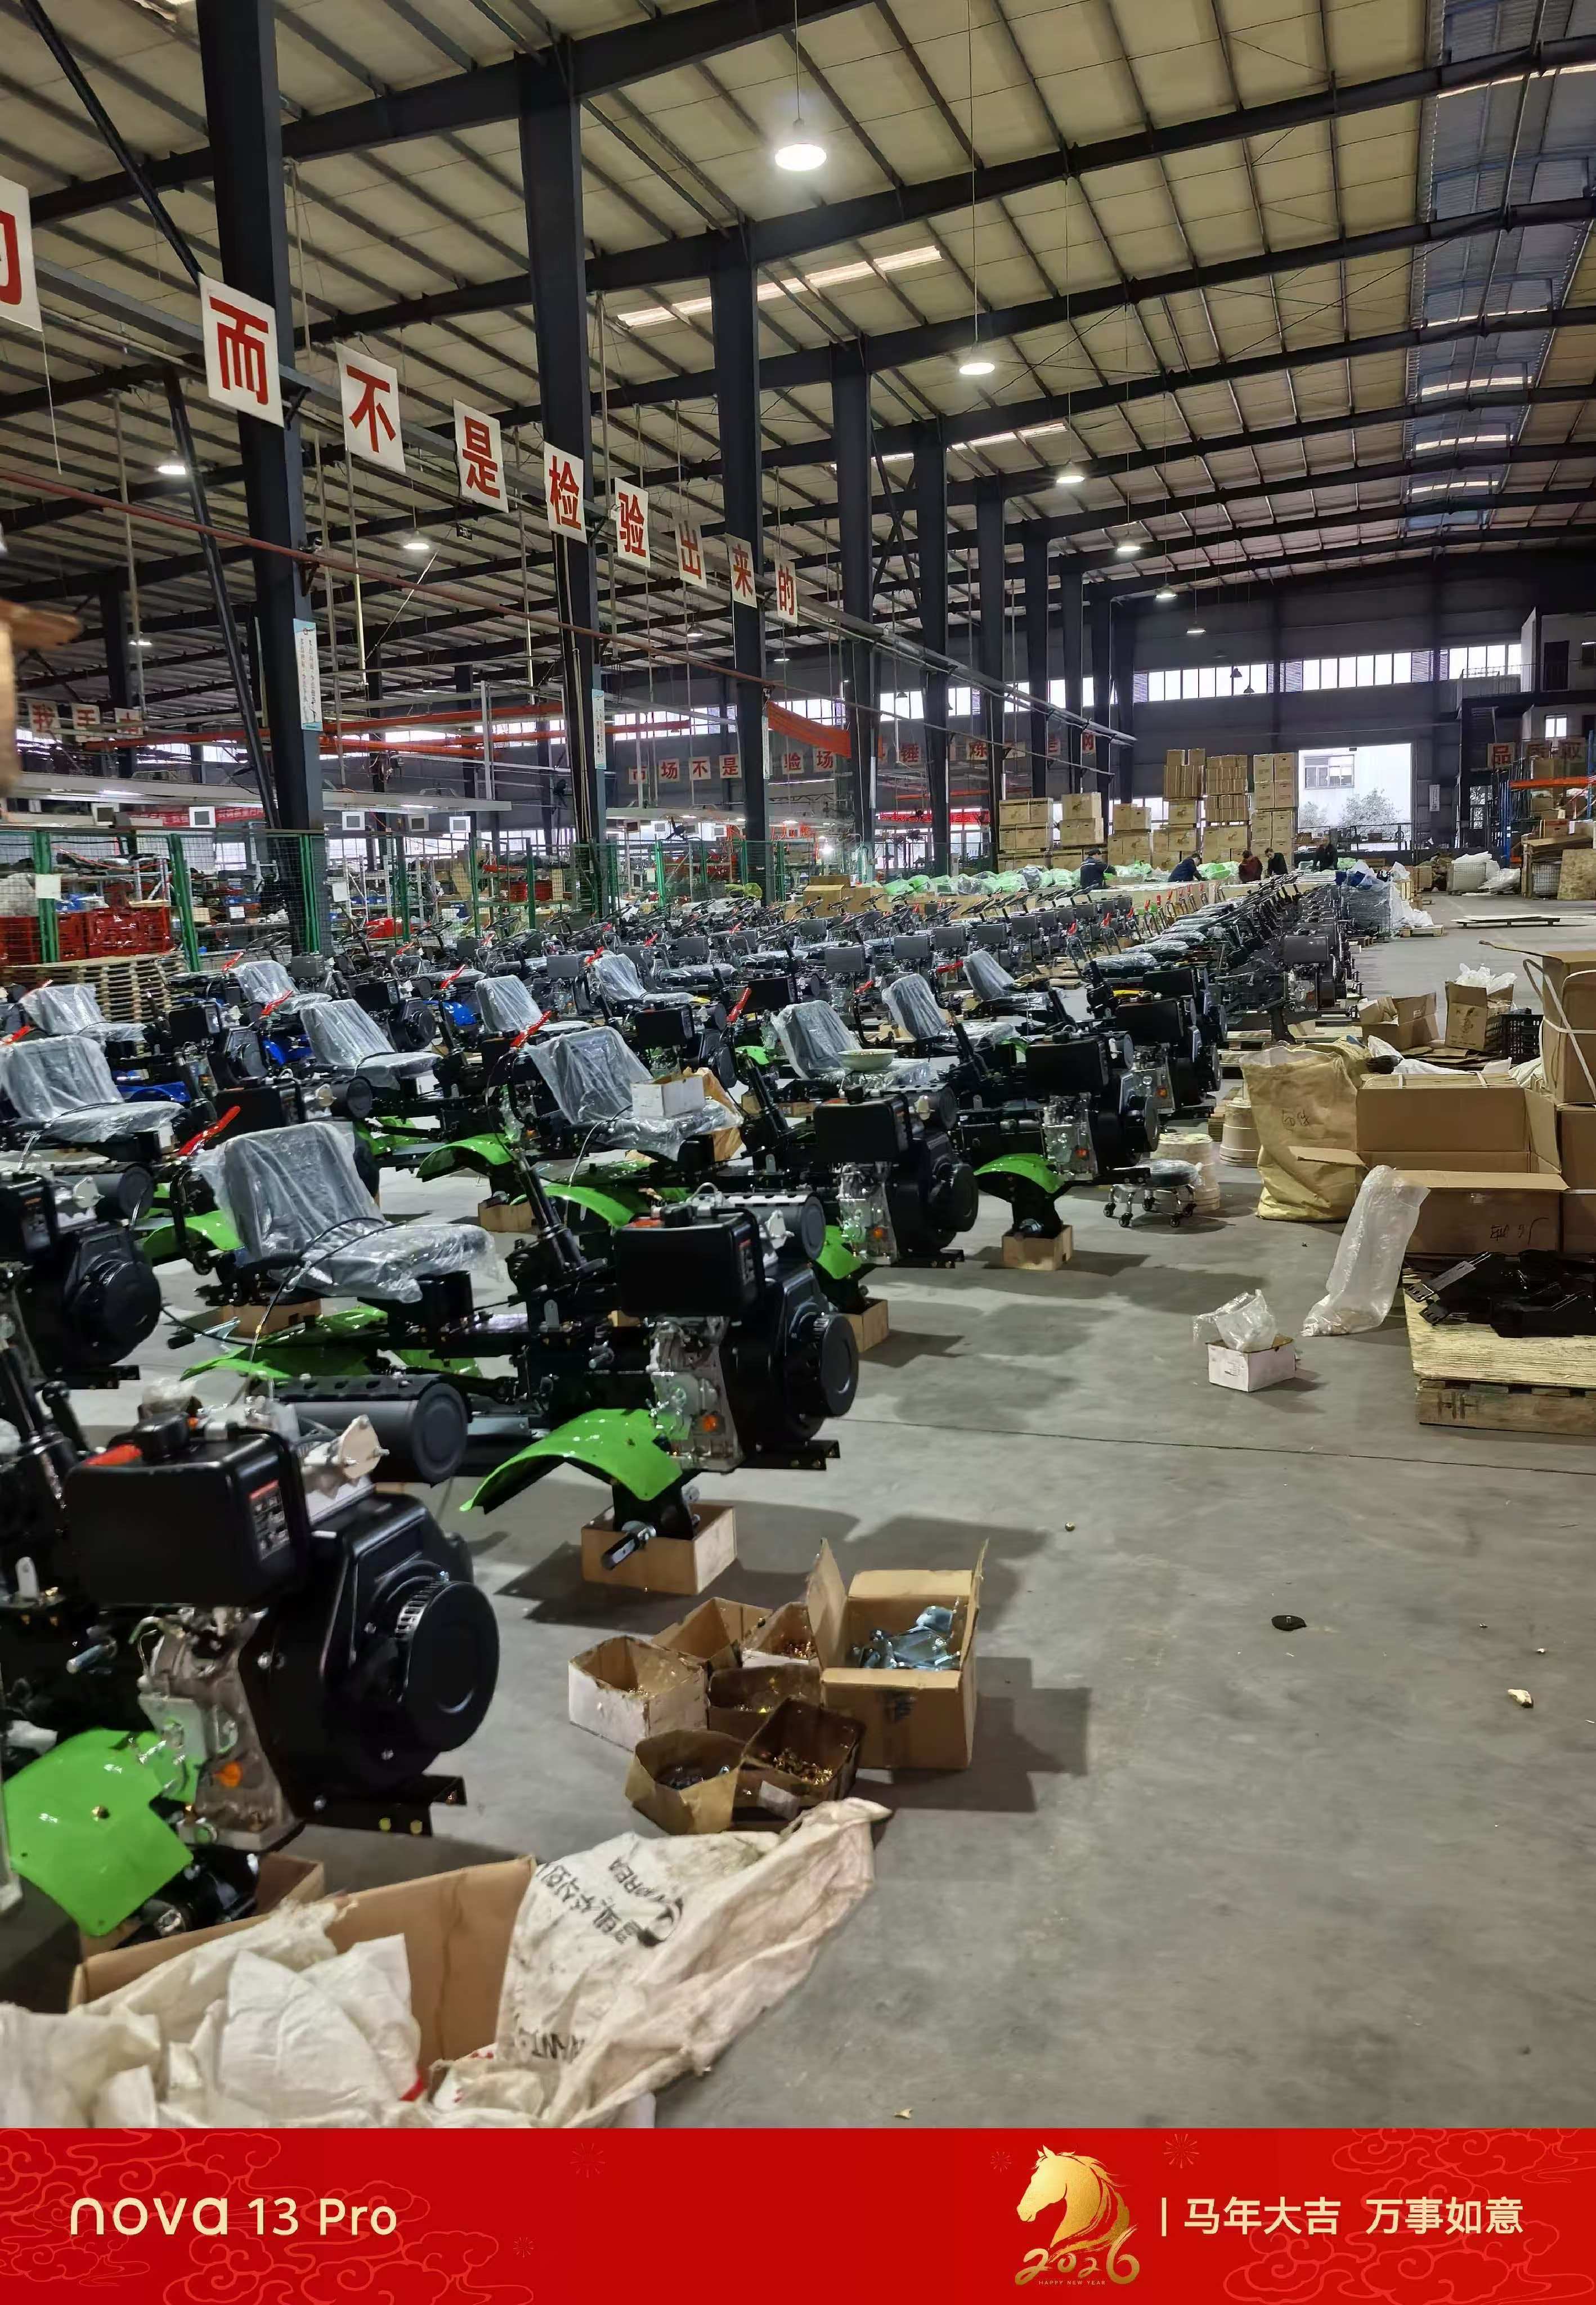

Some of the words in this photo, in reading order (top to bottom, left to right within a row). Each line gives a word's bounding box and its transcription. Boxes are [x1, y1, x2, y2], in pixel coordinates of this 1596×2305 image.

[210, 297, 268, 405] 而
[347, 365, 396, 452] 不
[463, 416, 500, 499] 是
[549, 455, 581, 530] 检
[619, 492, 646, 558] 验
[679, 530, 702, 580] 出
[732, 544, 753, 598] 来
[779, 569, 795, 616] 的
[692, 761, 707, 777] 不
[723, 757, 738, 776] 是
